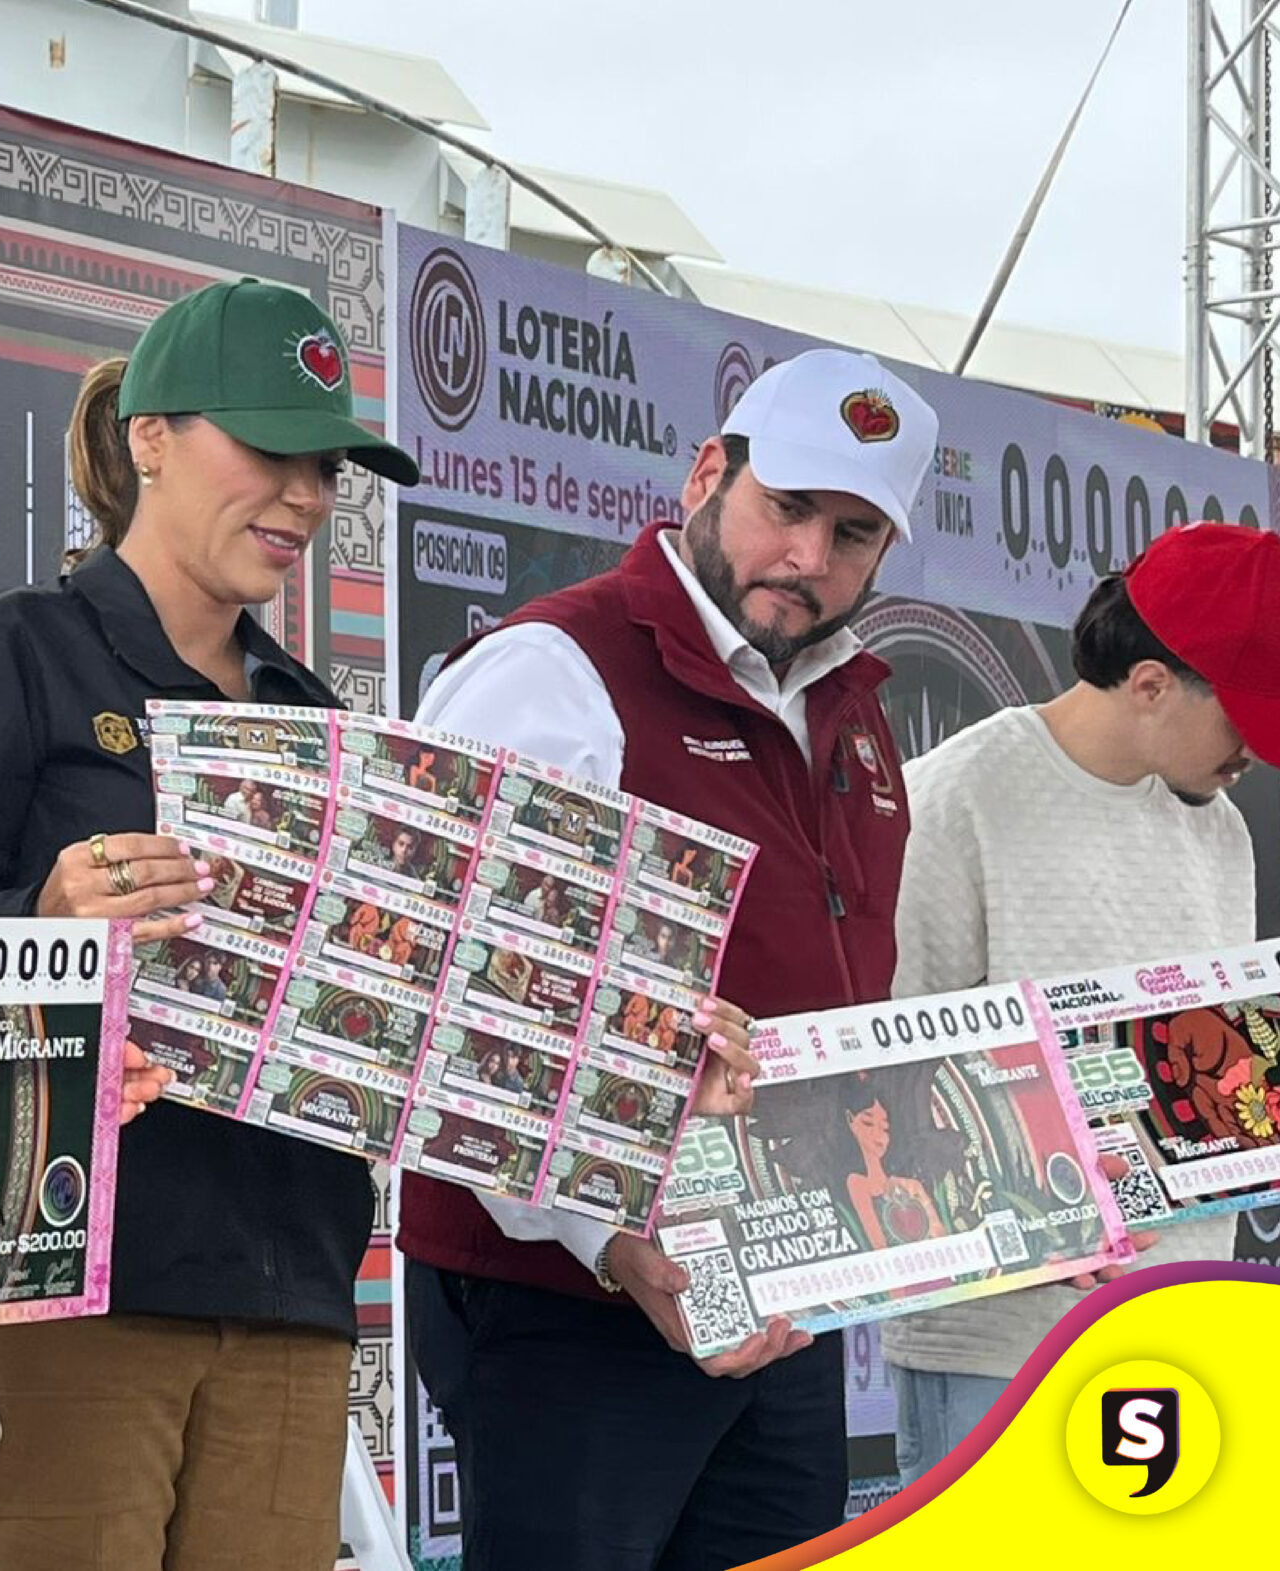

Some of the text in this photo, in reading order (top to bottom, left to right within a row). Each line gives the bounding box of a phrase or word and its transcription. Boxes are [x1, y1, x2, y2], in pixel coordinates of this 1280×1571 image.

[498, 300, 637, 385] LOTERÍA
[416, 435, 683, 535] Lunes 15 de septie
[933, 445, 974, 482] SERIE
[934, 482, 973, 538] ÚNICA
[416, 531, 505, 580] POSICIÓN 09
[1042, 978, 1103, 1000] LOTERÍA
[871, 996, 1025, 1049] 0000000
[676, 1128, 736, 1174] 55
[733, 1194, 798, 1221] NACIMOS
[800, 1188, 832, 1209] CON
[740, 1214, 809, 1242] LEGADO
[812, 1207, 838, 1228] DE
[17, 1229, 86, 1253] $200.00
[739, 1227, 859, 1270] GRANDEZA
